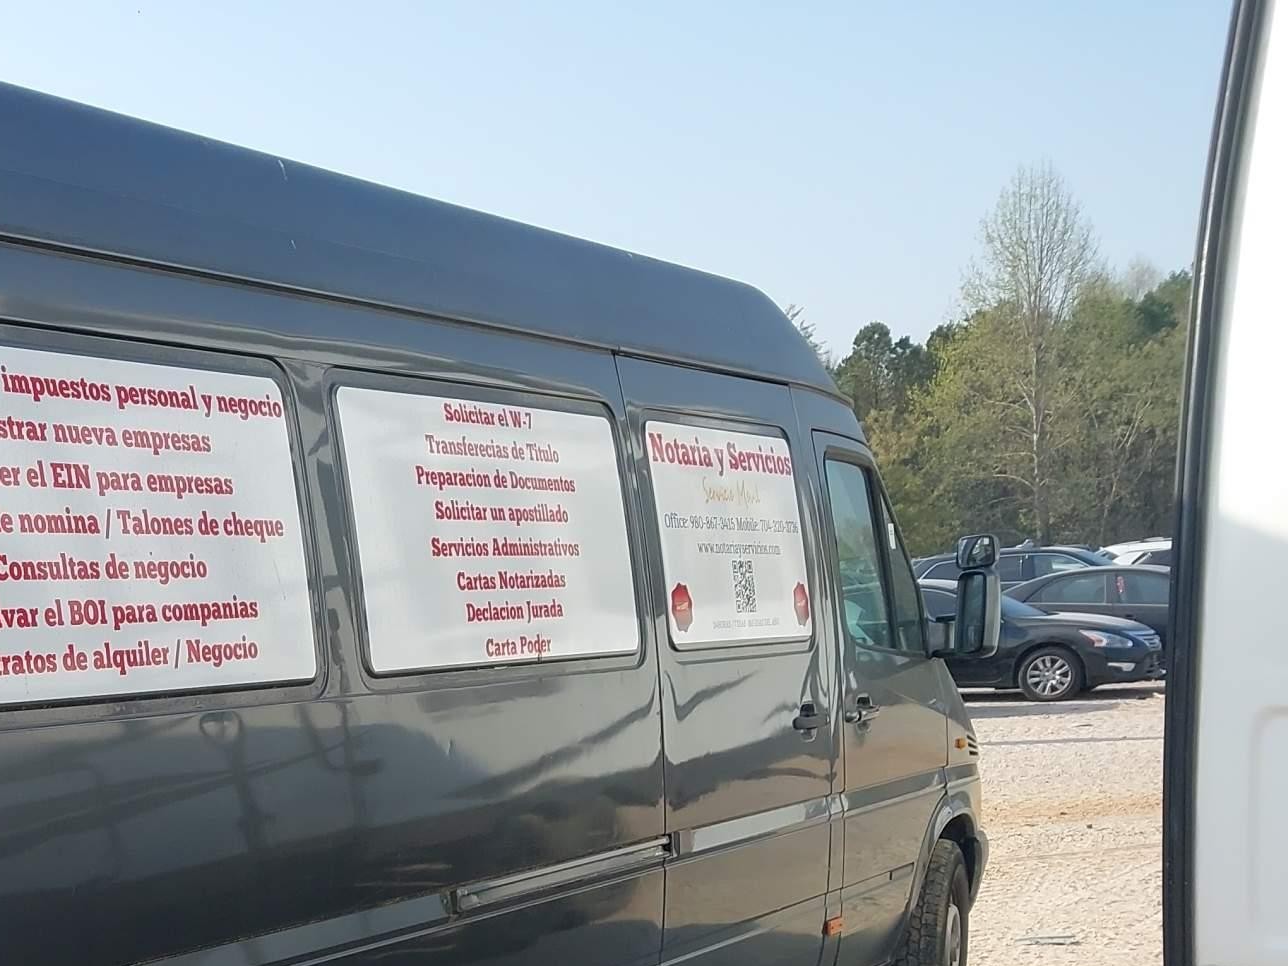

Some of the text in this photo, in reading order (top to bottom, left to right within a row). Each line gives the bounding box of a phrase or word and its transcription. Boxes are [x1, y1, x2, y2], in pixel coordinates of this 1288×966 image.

[1, 364, 111, 404] impuestos
[115, 383, 198, 413] personal
[201, 394, 213, 419] y
[217, 394, 283, 421] negocio
[443, 402, 532, 430] Solicitar el W-7
[53, 422, 118, 448] nueva
[121, 429, 212, 456] empresas
[511, 442, 526, 460] de
[526, 442, 560, 464] Titulo
[648, 432, 792, 476] Notaria y Servicios
[25, 460, 48, 488] el
[51, 461, 91, 490] EIN
[97, 472, 143, 496] para
[146, 473, 234, 499] empresas
[416, 466, 576, 492] Preparacion de Documentos
[18, 508, 101, 535] nomina
[104, 507, 111, 539] /
[115, 510, 195, 536] Talones
[197, 511, 220, 536] de
[223, 511, 285, 543] cheque
[434, 500, 568, 526] Solicitar un apostillado
[432, 537, 580, 557] Servicios Administrativos
[104, 553, 130, 579] de
[134, 554, 208, 584] negocio
[456, 570, 566, 590] Cartas Notarizadas
[44, 599, 66, 627] el
[67, 599, 108, 626] BOI
[112, 600, 158, 631] para
[161, 595, 259, 626] companias
[466, 599, 563, 624] Declacion Jurada
[61, 646, 89, 673] de
[91, 642, 171, 678] alquiler
[175, 639, 182, 669] /
[186, 636, 259, 665] Negocio
[486, 634, 551, 656] Carta Poder
